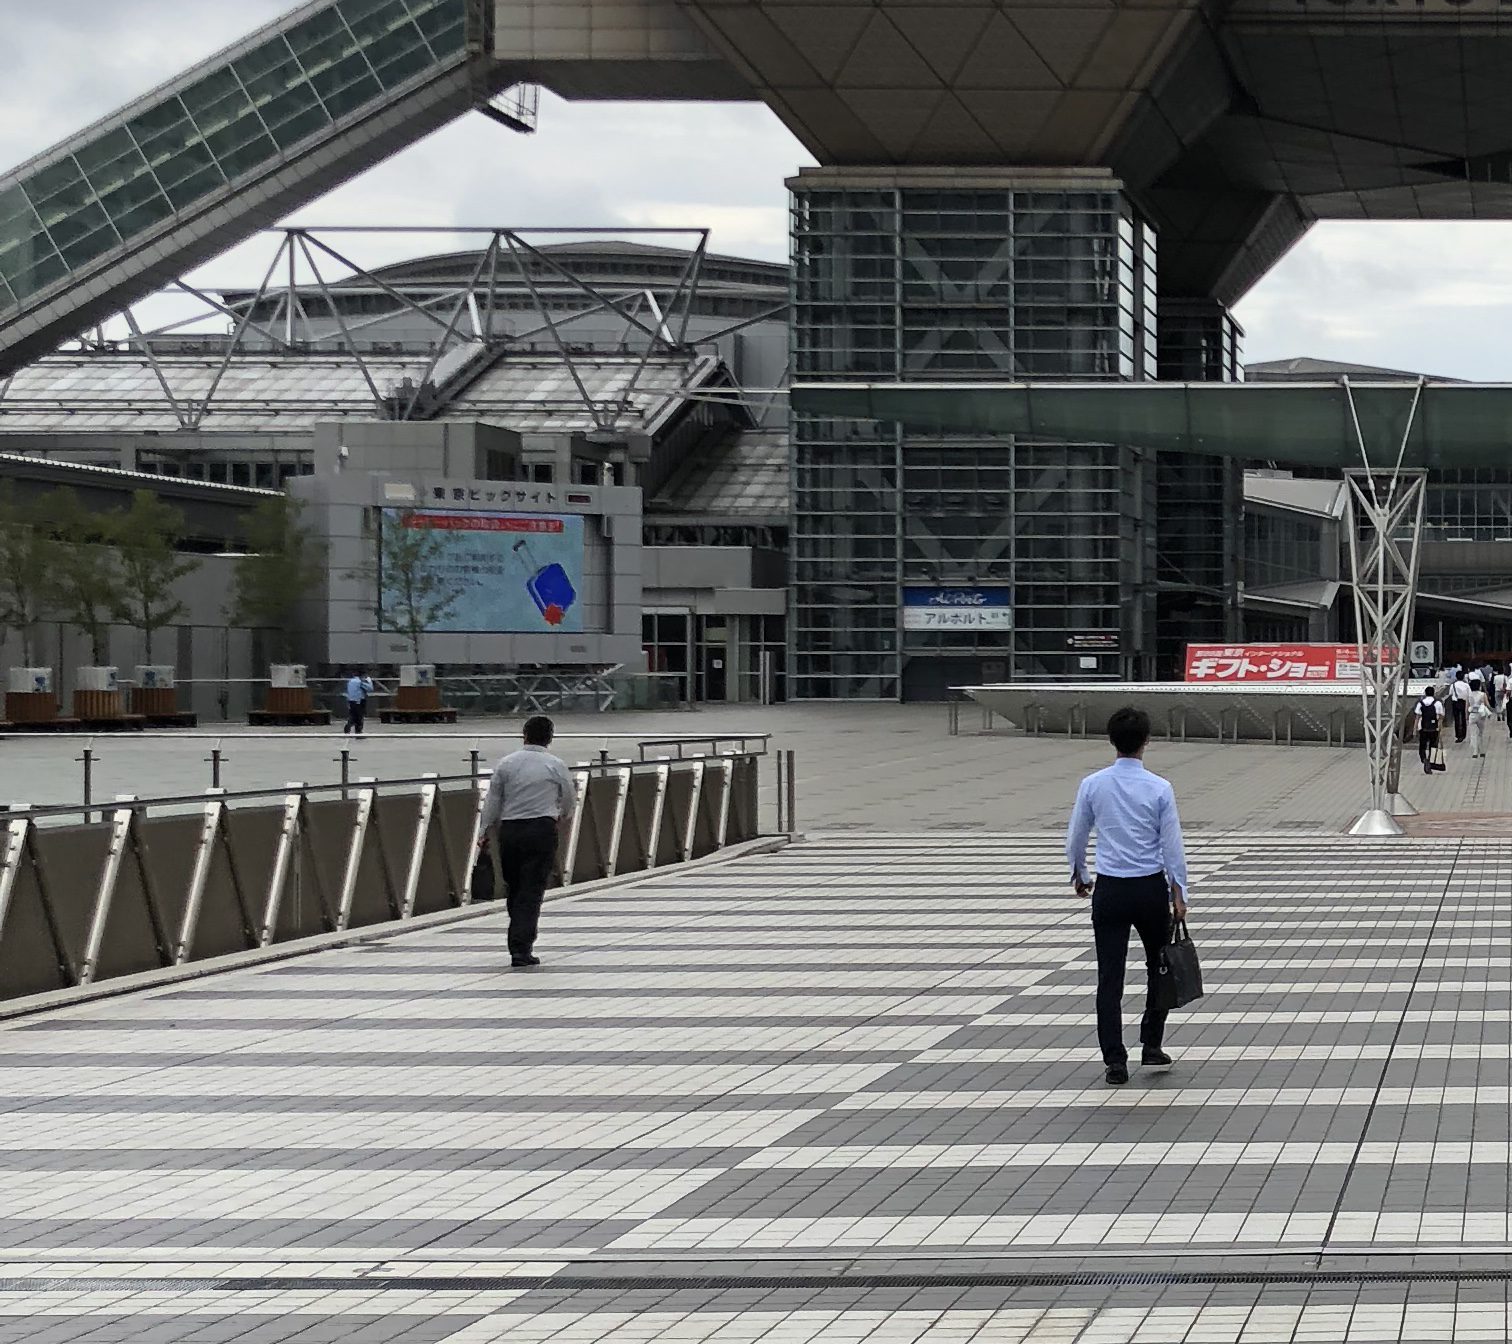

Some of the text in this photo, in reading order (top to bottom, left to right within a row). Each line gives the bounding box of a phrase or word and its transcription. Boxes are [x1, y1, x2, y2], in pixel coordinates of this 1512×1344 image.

[1189, 658, 1330, 678] ギフト・ショー
